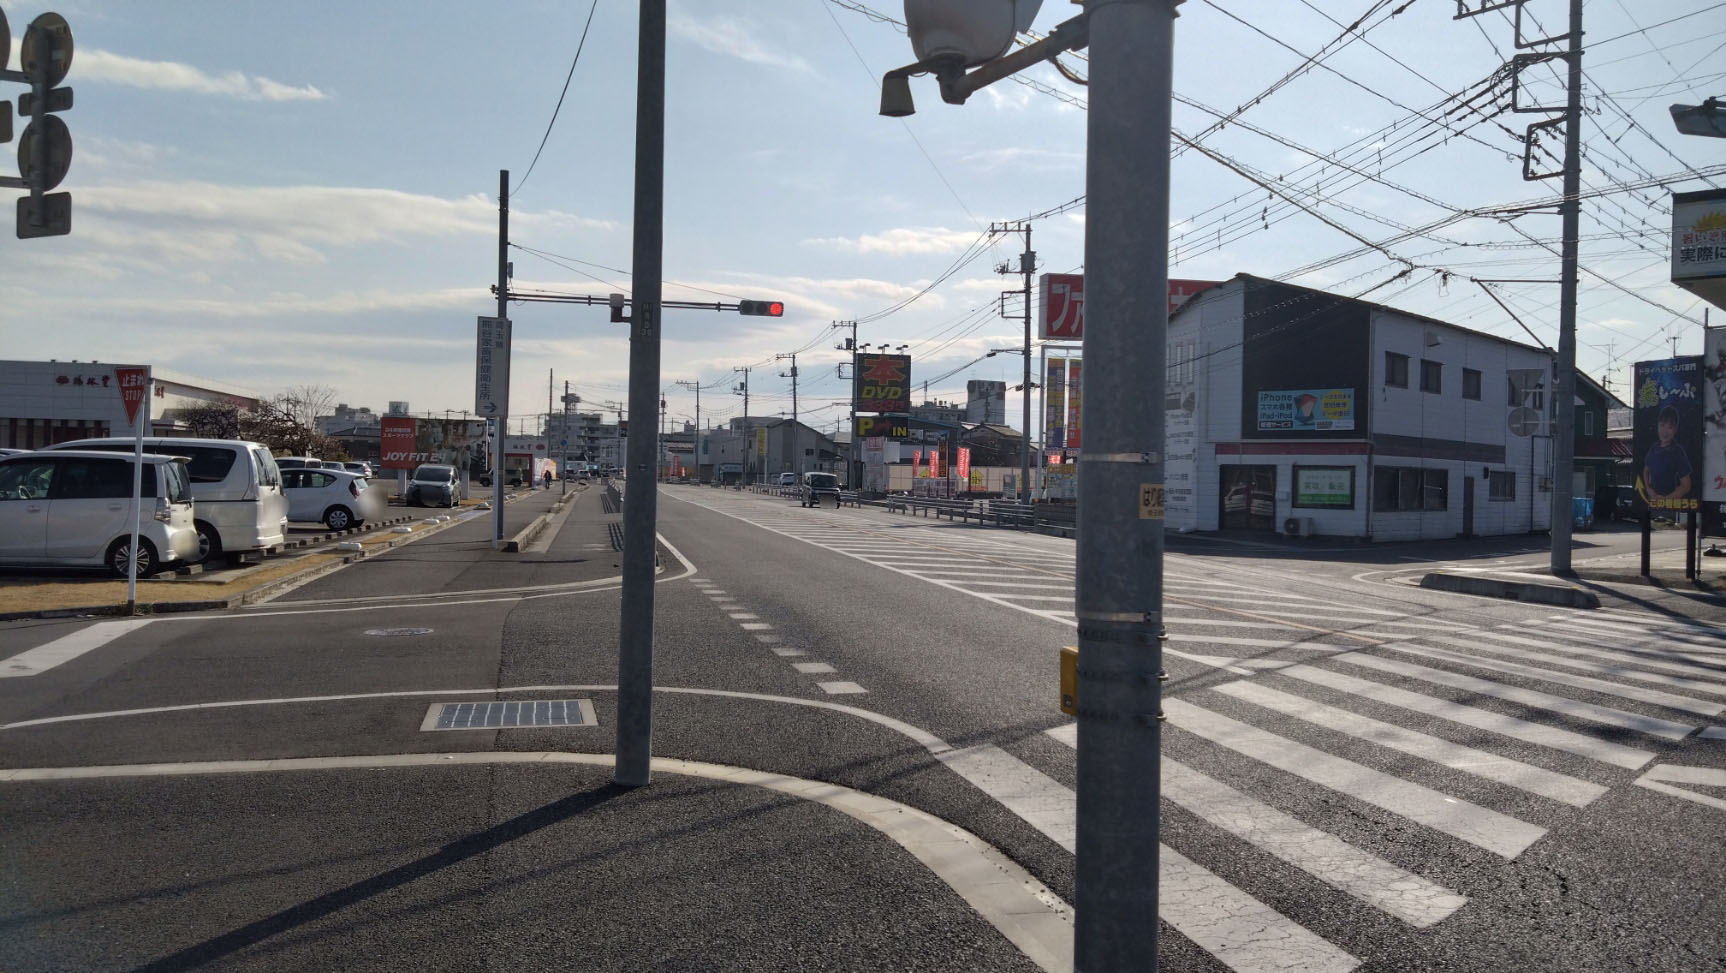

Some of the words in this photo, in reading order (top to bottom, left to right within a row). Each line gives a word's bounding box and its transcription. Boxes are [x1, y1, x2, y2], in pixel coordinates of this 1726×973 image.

[1680, 246, 1726, 263] 実際に
[862, 354, 905, 385] 本
[121, 374, 144, 387] 止まれ
[125, 390, 143, 401] STOP
[861, 386, 902, 400] DVD
[1260, 393, 1293, 402] iPhone
[858, 417, 874, 436] P
[892, 426, 907, 437] IN
